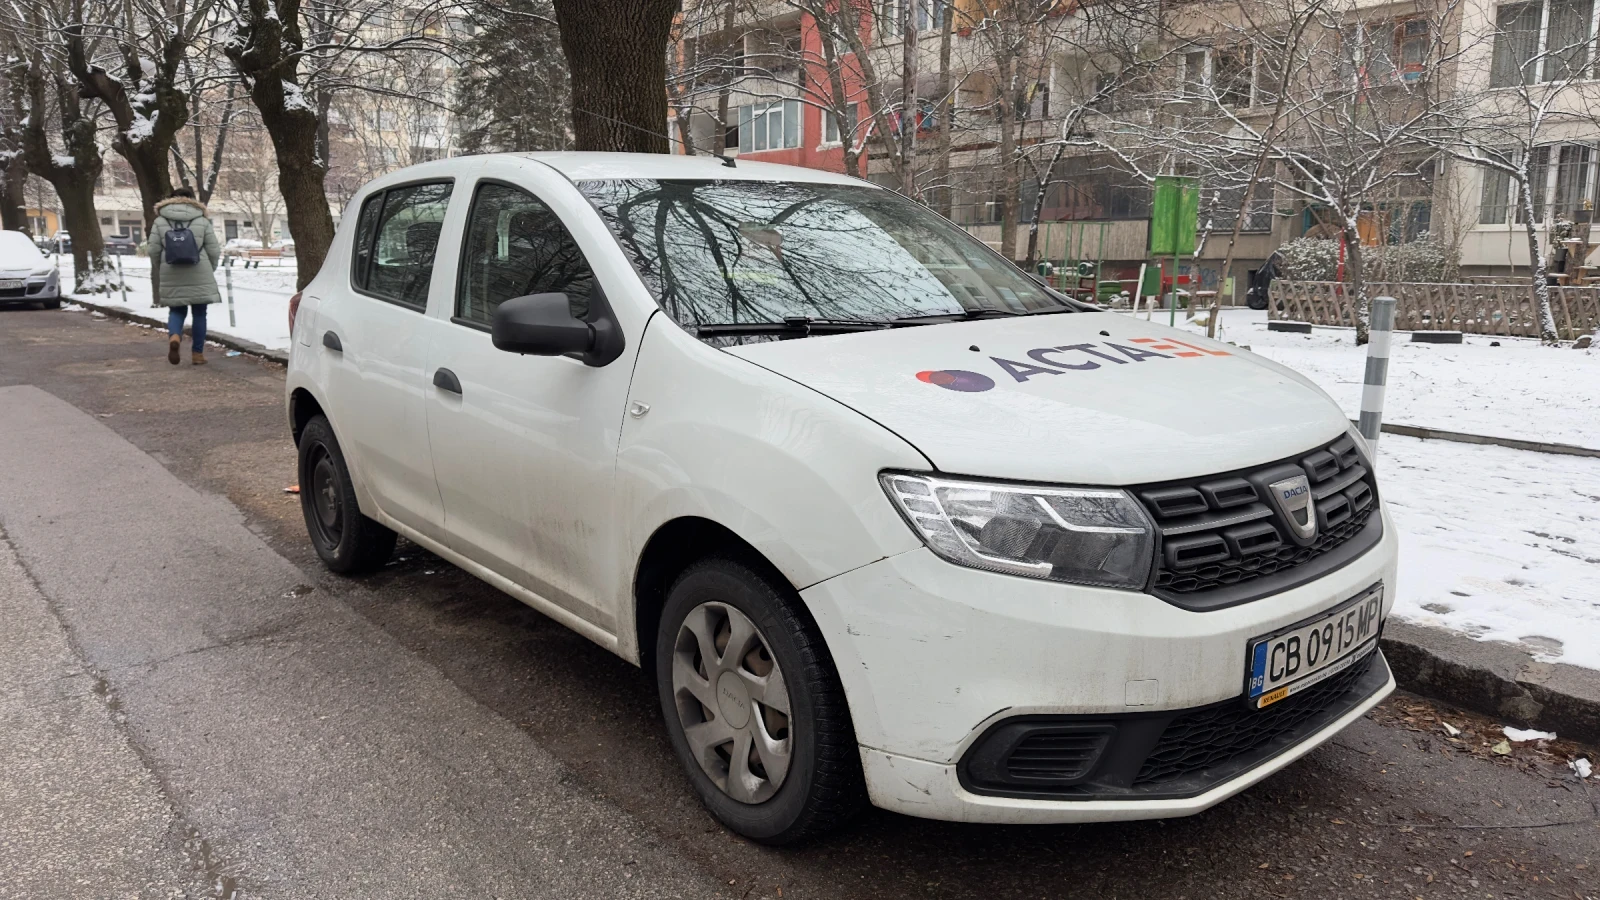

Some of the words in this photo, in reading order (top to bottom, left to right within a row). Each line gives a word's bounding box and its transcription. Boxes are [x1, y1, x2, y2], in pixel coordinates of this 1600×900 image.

[989, 341, 1176, 383] ACTA
[1284, 485, 1308, 499] DACIA
[1269, 635, 1300, 682] CB
[1252, 675, 1263, 689] BG
